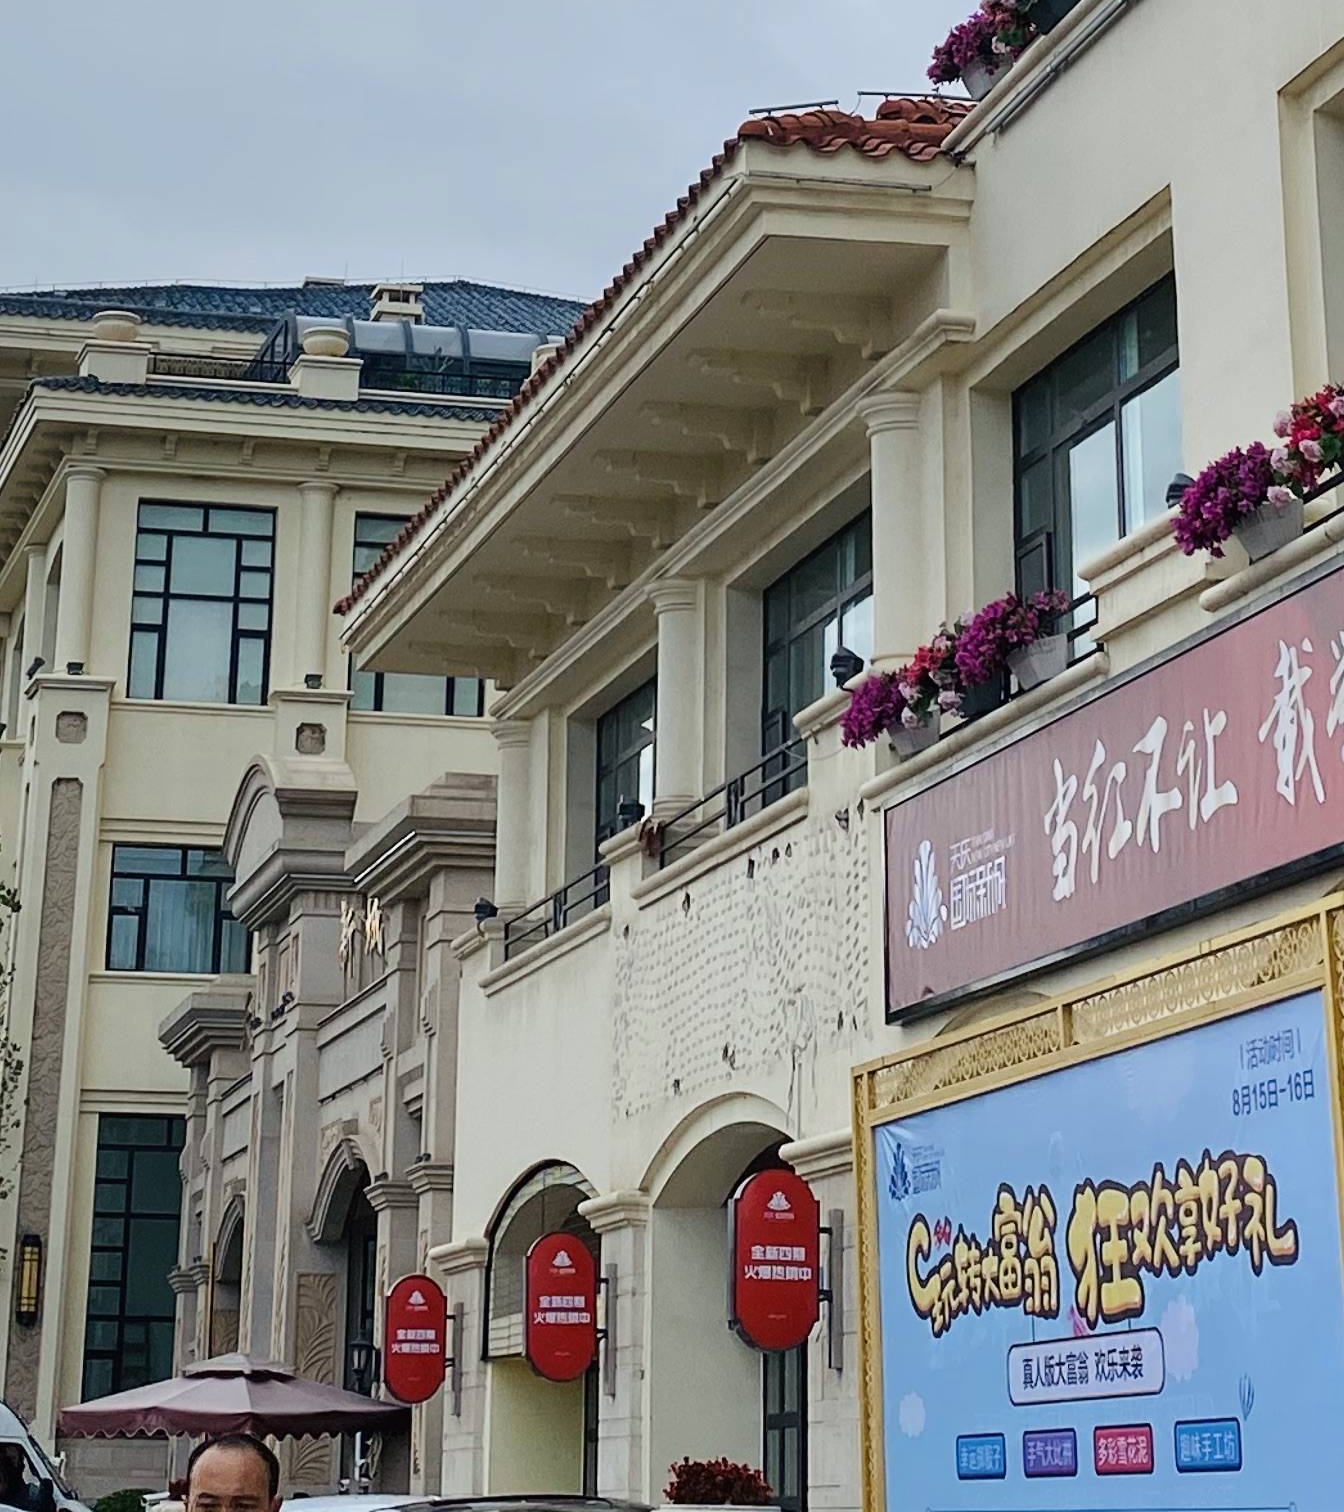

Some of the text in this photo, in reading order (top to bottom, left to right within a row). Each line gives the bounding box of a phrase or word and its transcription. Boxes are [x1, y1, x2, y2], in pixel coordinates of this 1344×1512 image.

[1232, 1069, 1315, 1116] 8月15日-16日
[1067, 1148, 1299, 1330] 狂欢享好礼
[1022, 1344, 1144, 1390] 真人版大富翁 欢乐来袭
